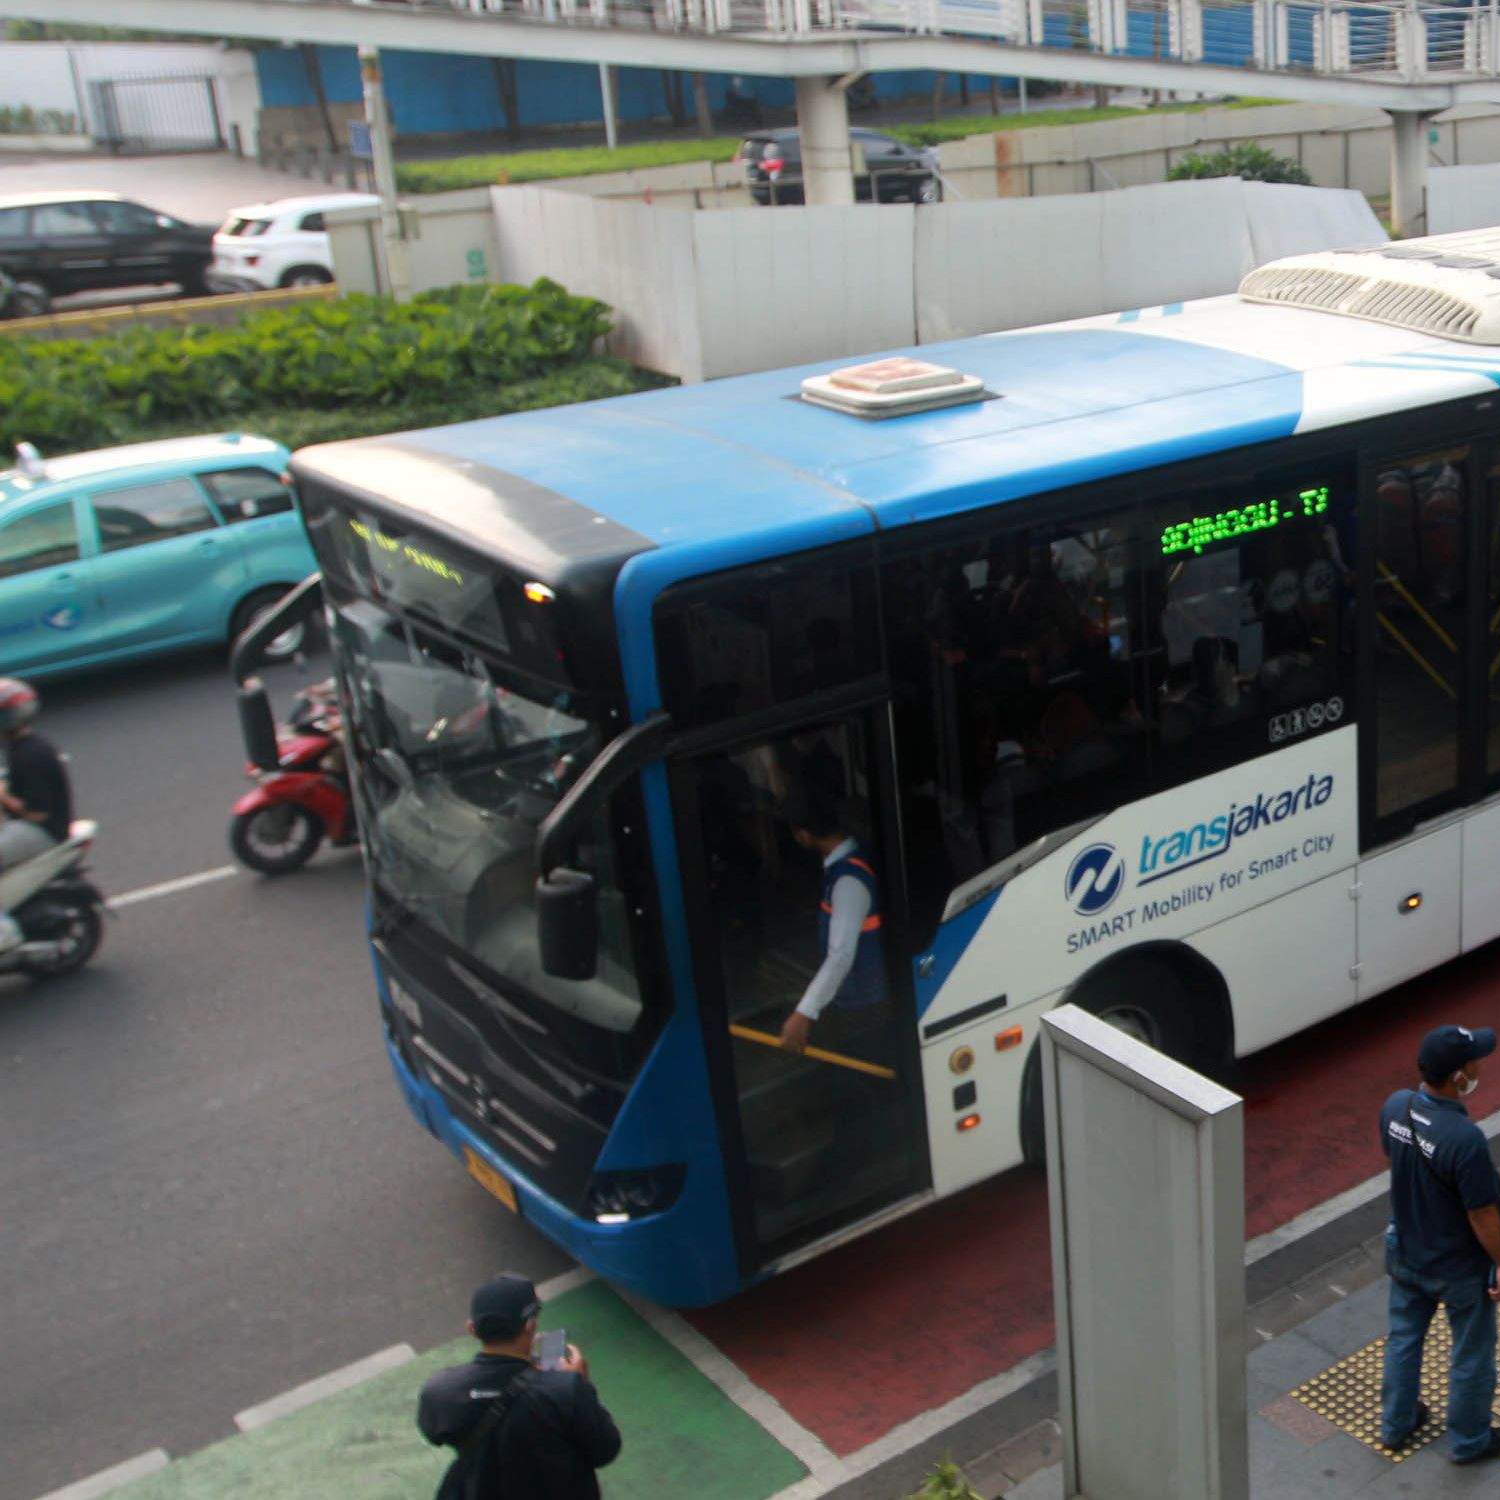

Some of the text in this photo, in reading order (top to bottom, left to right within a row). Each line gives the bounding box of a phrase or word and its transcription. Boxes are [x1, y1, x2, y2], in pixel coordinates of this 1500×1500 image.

[1138, 774, 1335, 875] transjakarta
[1066, 832, 1336, 954] SMART Mobility for Smart City
